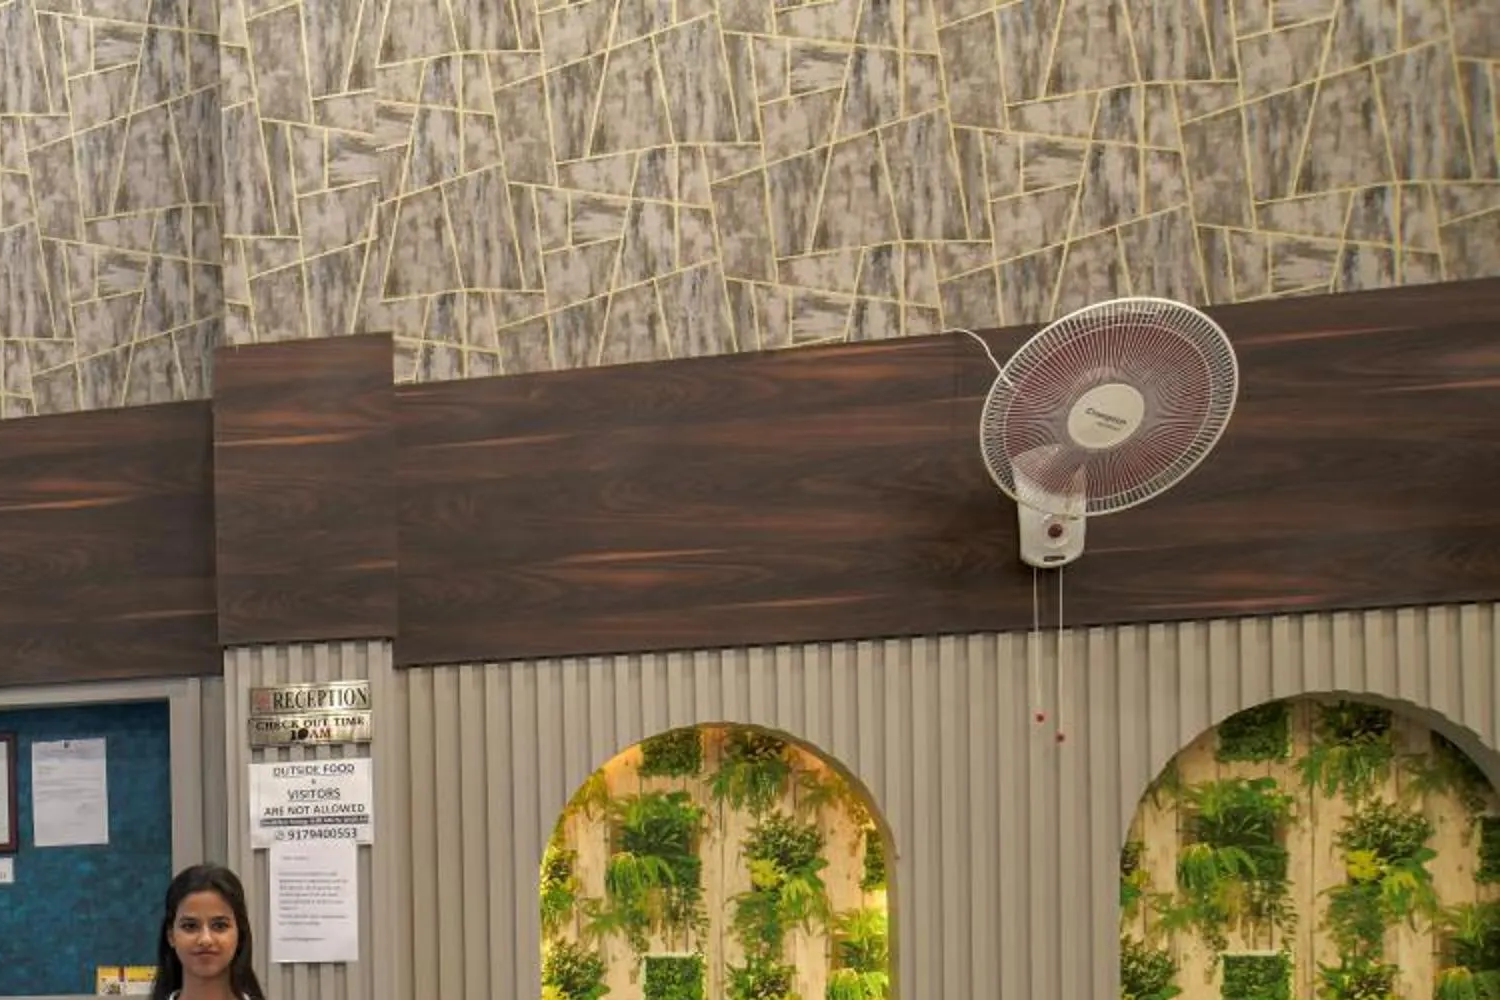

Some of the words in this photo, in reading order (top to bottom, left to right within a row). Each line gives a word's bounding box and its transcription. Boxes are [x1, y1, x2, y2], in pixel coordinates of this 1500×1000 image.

[273, 687, 367, 709] RECEPTION
[256, 720, 300, 730] CHECK
[303, 719, 329, 728] OUT
[334, 716, 365, 726] TIME
[323, 762, 355, 774] FOOD
[287, 788, 341, 800] VISITORS
[263, 807, 285, 816] ARE
[287, 805, 311, 815] NOT
[313, 803, 366, 814] ALLOWED
